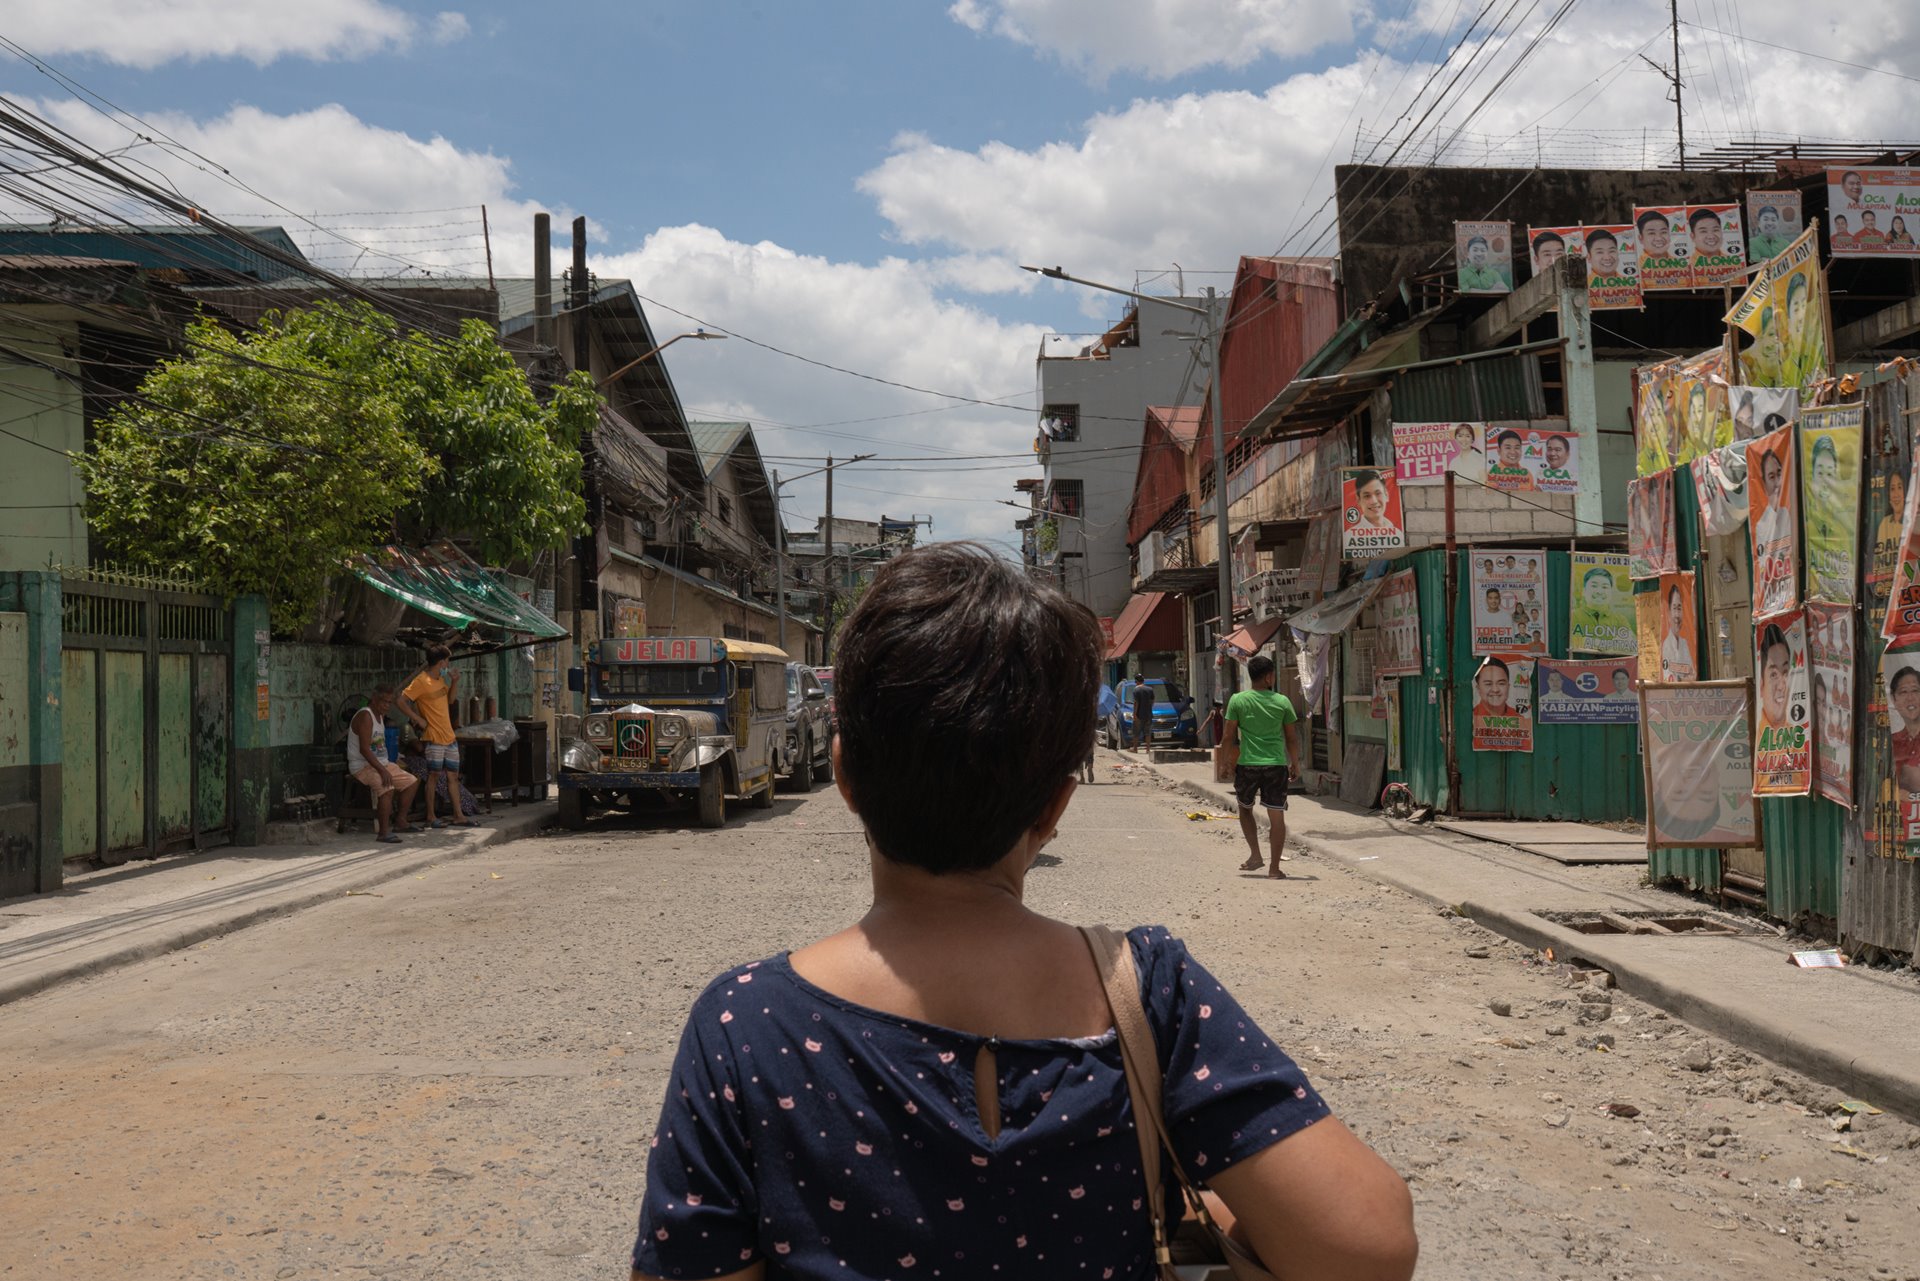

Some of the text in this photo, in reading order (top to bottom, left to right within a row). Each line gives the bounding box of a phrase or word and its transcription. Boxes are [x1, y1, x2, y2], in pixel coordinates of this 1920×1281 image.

[1864, 194, 1885, 203] OCA
[1895, 193, 1920, 206] ALO
[1671, 223, 1686, 233] AM
[1723, 221, 1739, 230] AM
[1619, 242, 1636, 252] AM
[1642, 257, 1688, 269] ALONG
[1694, 255, 1741, 267] ALONG
[1590, 276, 1637, 288] ALONG
[1394, 424, 1450, 435] WE SUPPORT
[1394, 432, 1451, 444] VICE MAYOR
[1395, 441, 1456, 459] KARINA
[1525, 445, 1542, 456] AM
[1400, 454, 1448, 477] TEH
[1489, 464, 1528, 475] ALONG
[1543, 468, 1571, 479] OCA
[1870, 477, 1885, 488] OTE
[1349, 508, 1358, 522] 3
[1351, 528, 1396, 537] TONTON
[1348, 537, 1401, 547] ASISTIO
[1351, 549, 1386, 559] COUNC
[1574, 556, 1596, 564] AKING
[1597, 556, 1622, 565] AYOR
[1276, 577, 1298, 586] CANT
[1476, 626, 1512, 637] TOPET
[1573, 623, 1629, 639] ALONG
[1477, 636, 1513, 644] ADALEM
[1574, 637, 1638, 652] ALAPITAN
[618, 640, 697, 661] JELAI
[1514, 673, 1529, 685] AM
[1582, 674, 1597, 690] 5
[1540, 703, 1639, 714] KABAYAN Partylist
[1758, 725, 1806, 752] ALONG
[1770, 774, 1793, 785] MAYOR
[1907, 803, 1920, 821] J
